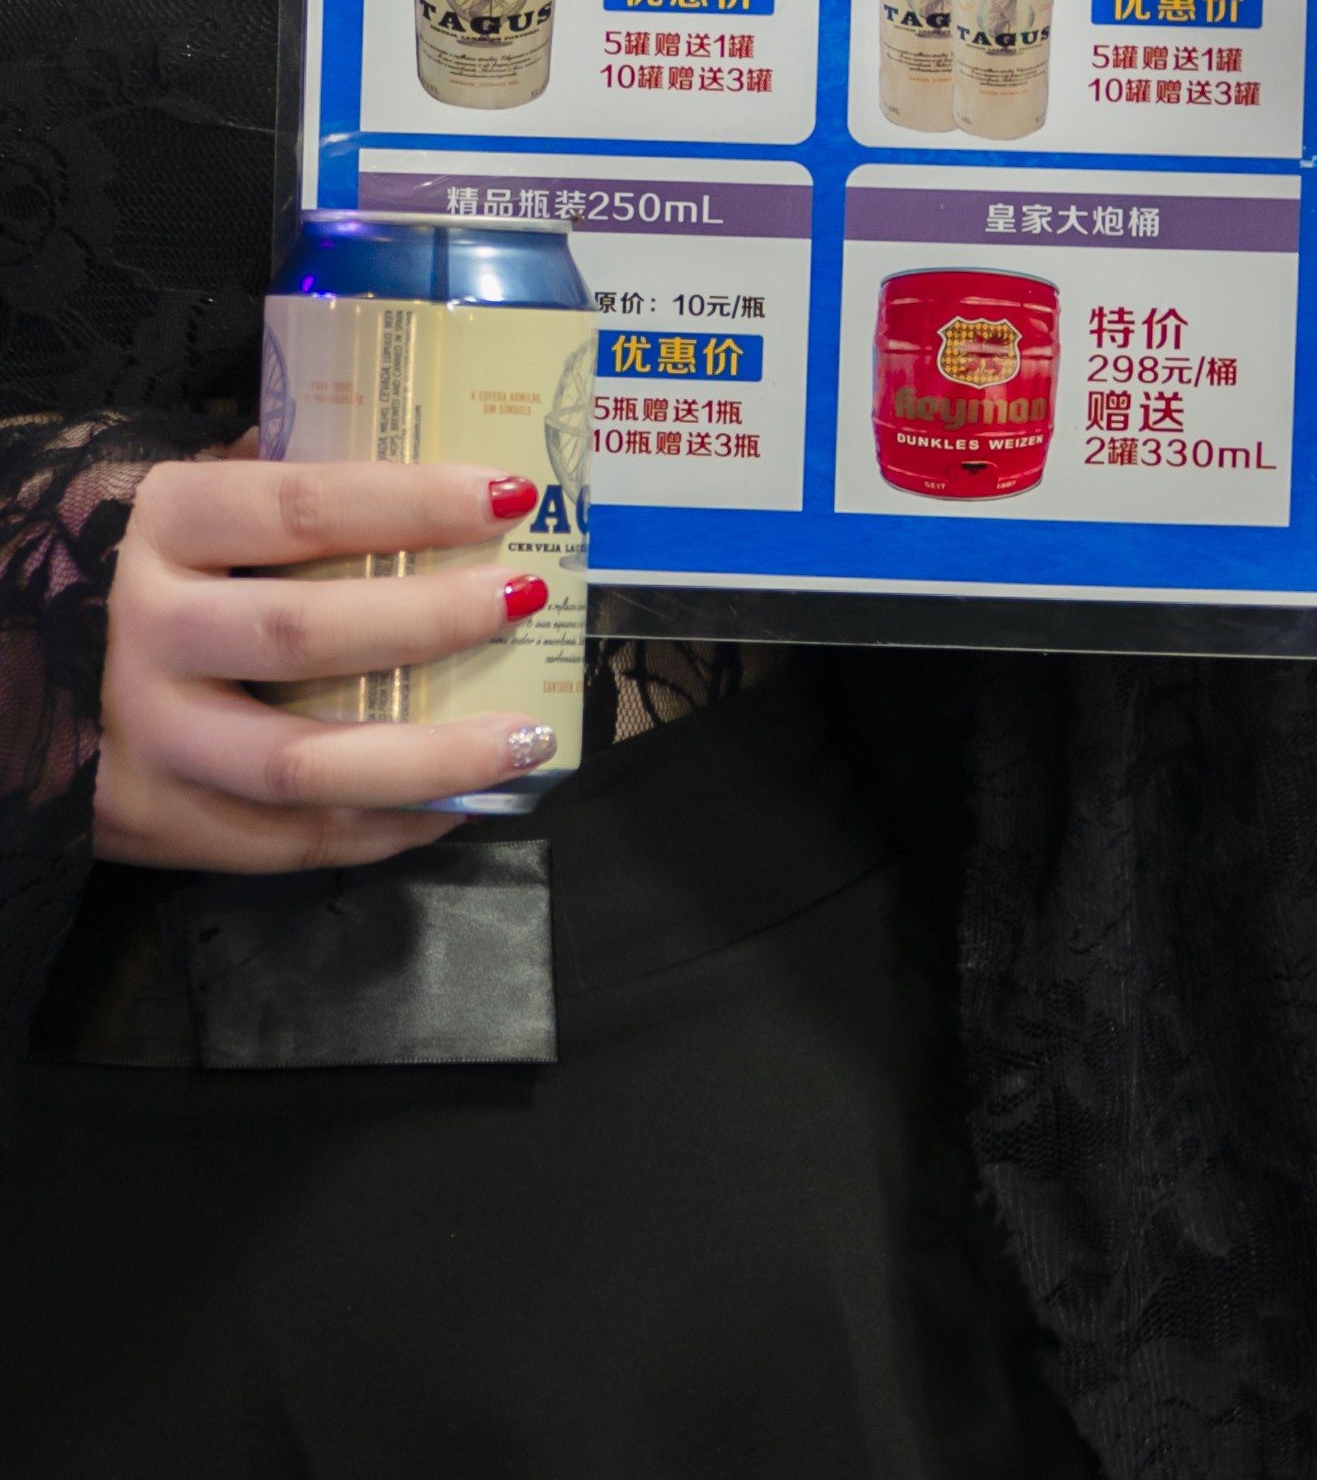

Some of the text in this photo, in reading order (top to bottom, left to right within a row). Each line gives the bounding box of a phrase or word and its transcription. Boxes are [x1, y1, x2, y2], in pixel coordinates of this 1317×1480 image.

[883, 3, 952, 29] TAG
[604, 30, 756, 59] 5罐赠送1罐
[957, 24, 1051, 47] TAGUS
[1092, 44, 1243, 73] 5罐赠送1罐
[600, 64, 774, 94] 10罐赠送3罐
[1088, 78, 1261, 107] 10罐赠送3罐
[446, 186, 725, 225] 精品瓶装250mL
[985, 202, 1161, 238] 皇家大炮桶
[1089, 306, 1189, 351] 特价
[612, 334, 744, 377] 优惠价
[1087, 353, 1238, 388] 298元/桶
[594, 396, 742, 425] 5瓶赠送1瓶
[1087, 389, 1184, 434] 赠送
[593, 429, 761, 459] 10瓶赠送3瓶
[897, 433, 1043, 450] DUNKLES WEIZEN
[1084, 435, 1277, 470] 2罐330mL
[508, 542, 561, 553] CERVEJA
